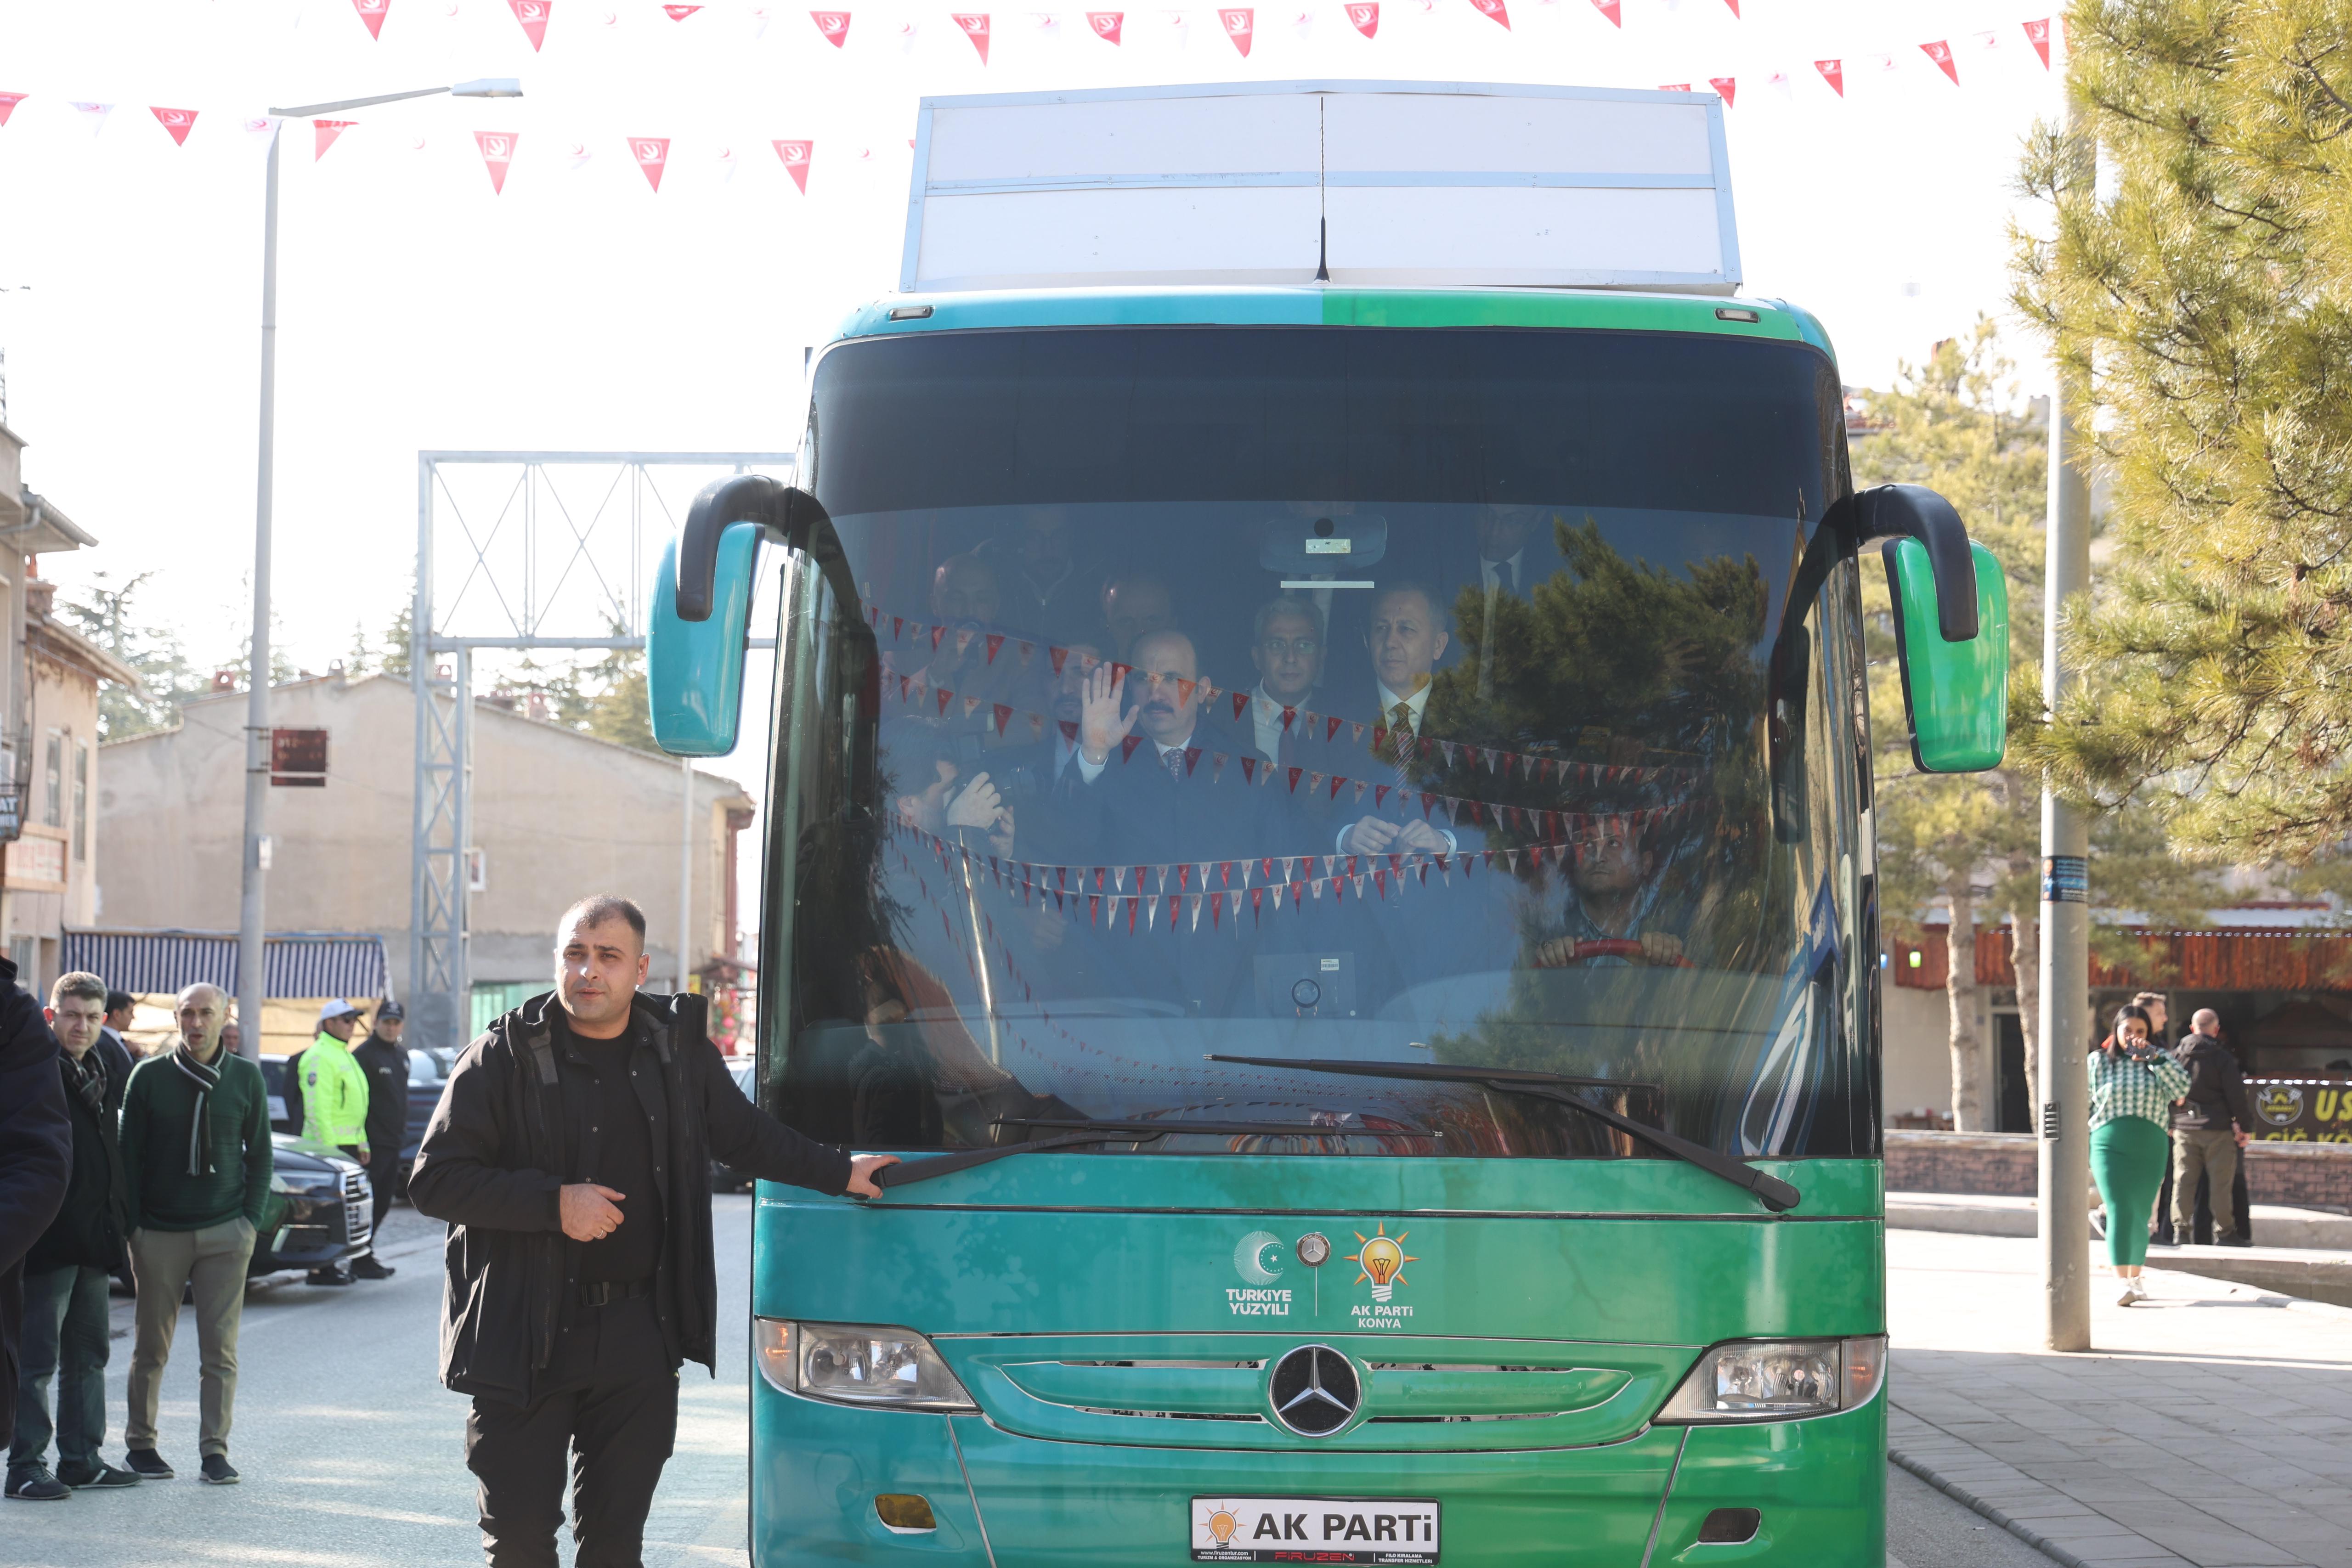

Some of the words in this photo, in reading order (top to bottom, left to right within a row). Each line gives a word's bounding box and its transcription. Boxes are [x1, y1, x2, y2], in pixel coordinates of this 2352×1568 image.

[1229, 1303, 1289, 1315] YÜZYILI
[1351, 1305, 1371, 1316] AK
[1358, 1318, 1402, 1328] KONYA
[1253, 1513, 1308, 1540] AK
